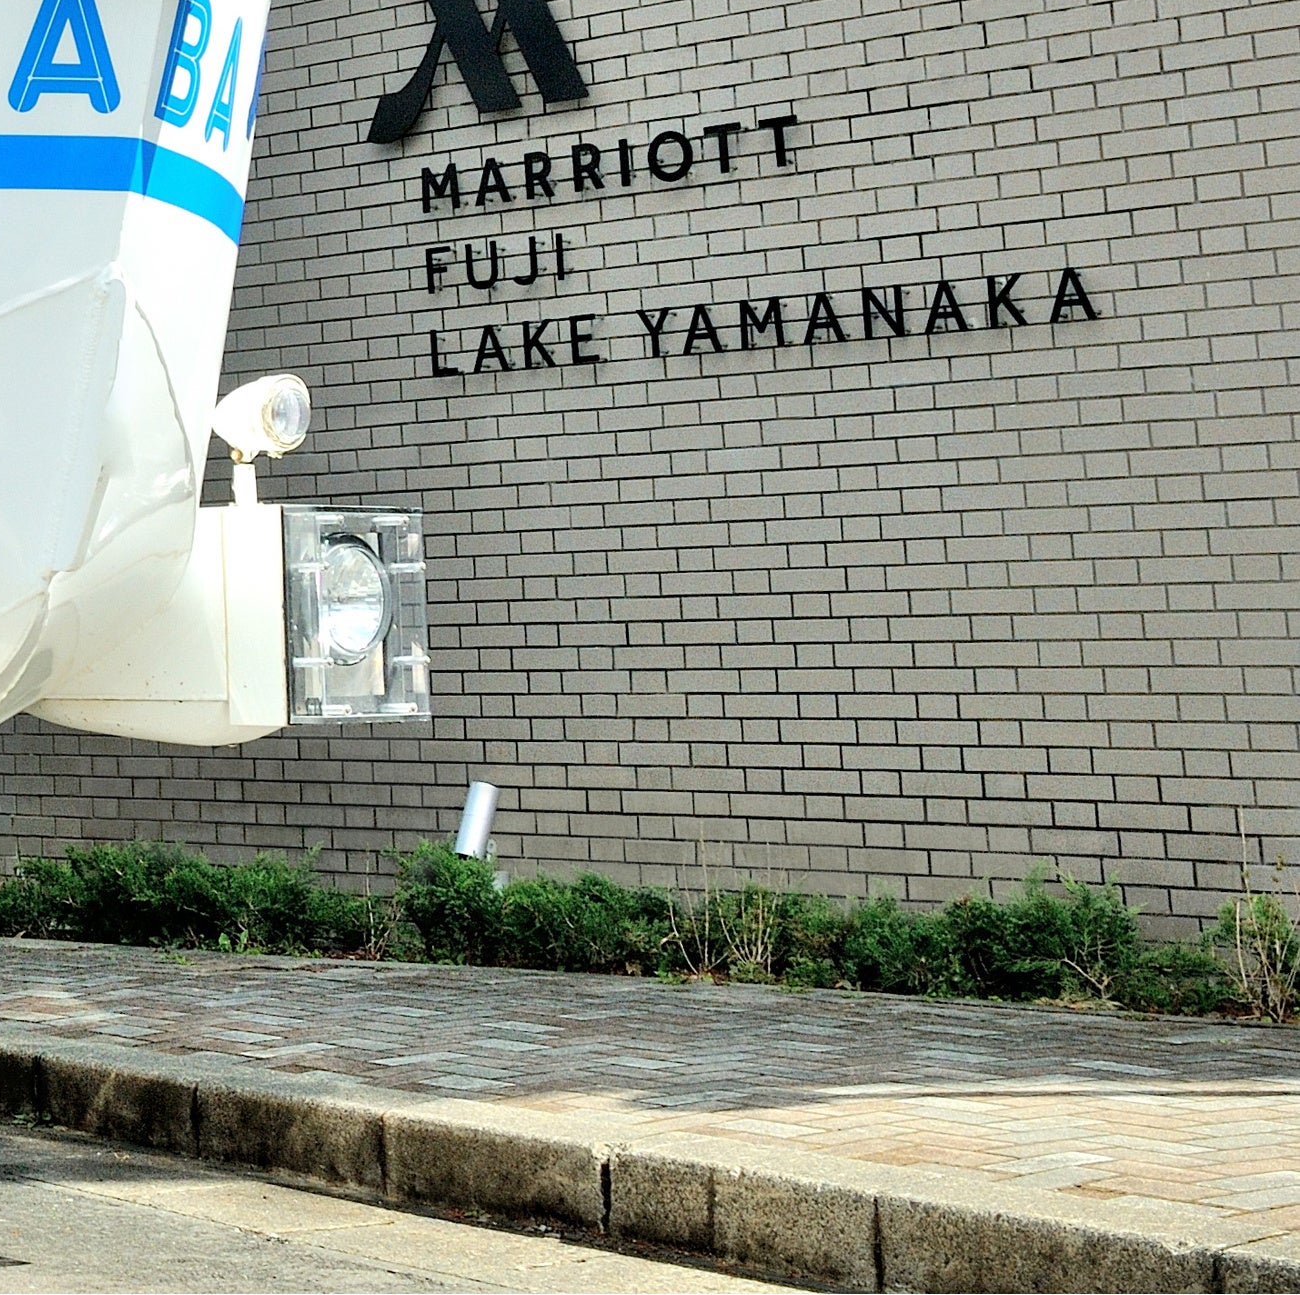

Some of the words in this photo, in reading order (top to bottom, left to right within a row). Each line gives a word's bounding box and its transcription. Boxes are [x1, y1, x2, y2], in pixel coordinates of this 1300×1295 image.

[421, 114, 799, 214] MARRIOTT
[426, 232, 572, 295] FUJI
[428, 313, 606, 379] LAKE
[636, 266, 1101, 360] YAMANAKA
